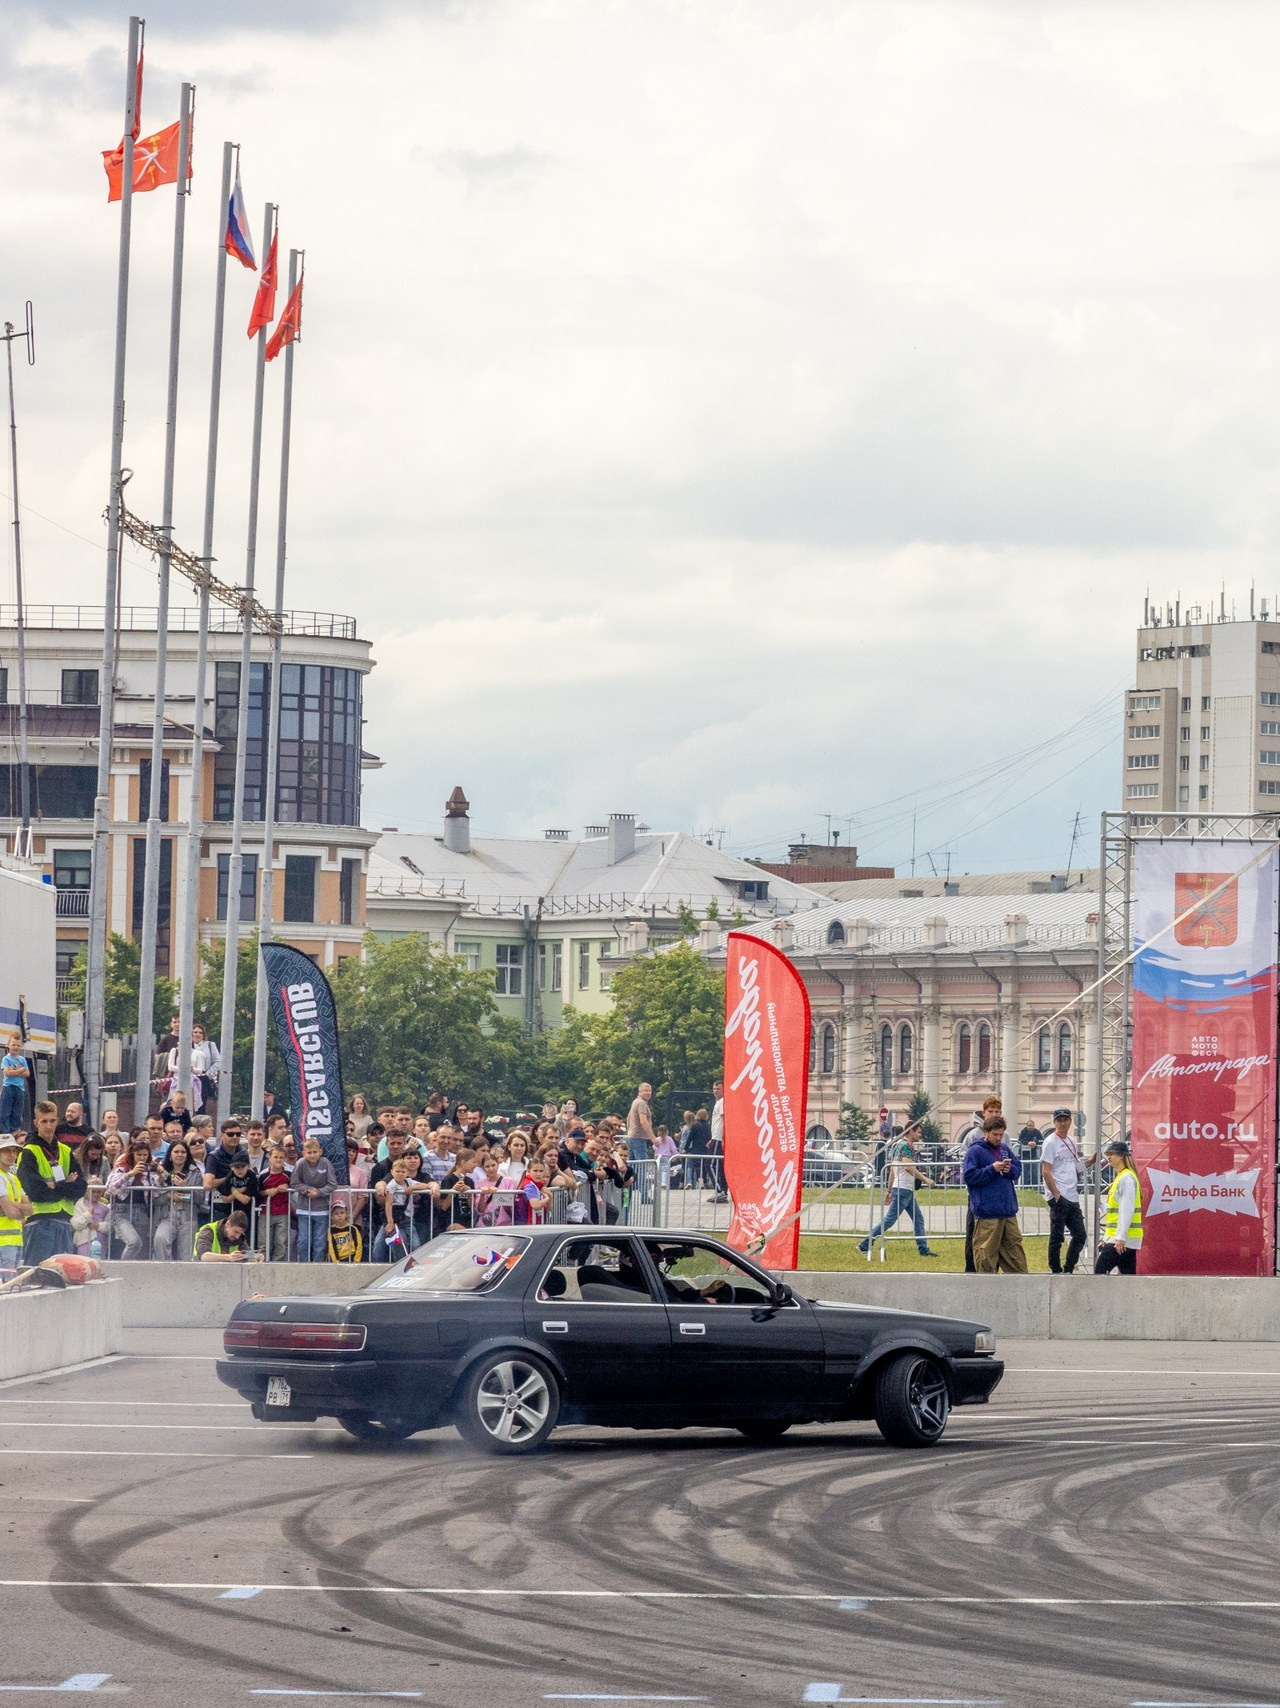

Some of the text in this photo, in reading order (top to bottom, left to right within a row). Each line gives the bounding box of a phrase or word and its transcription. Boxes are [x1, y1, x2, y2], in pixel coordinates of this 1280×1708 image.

[1137, 1053, 1271, 1088] Автострада
[1154, 1119, 1254, 1140] auto.ru
[1161, 1184, 1245, 1201] Альфа Банк
